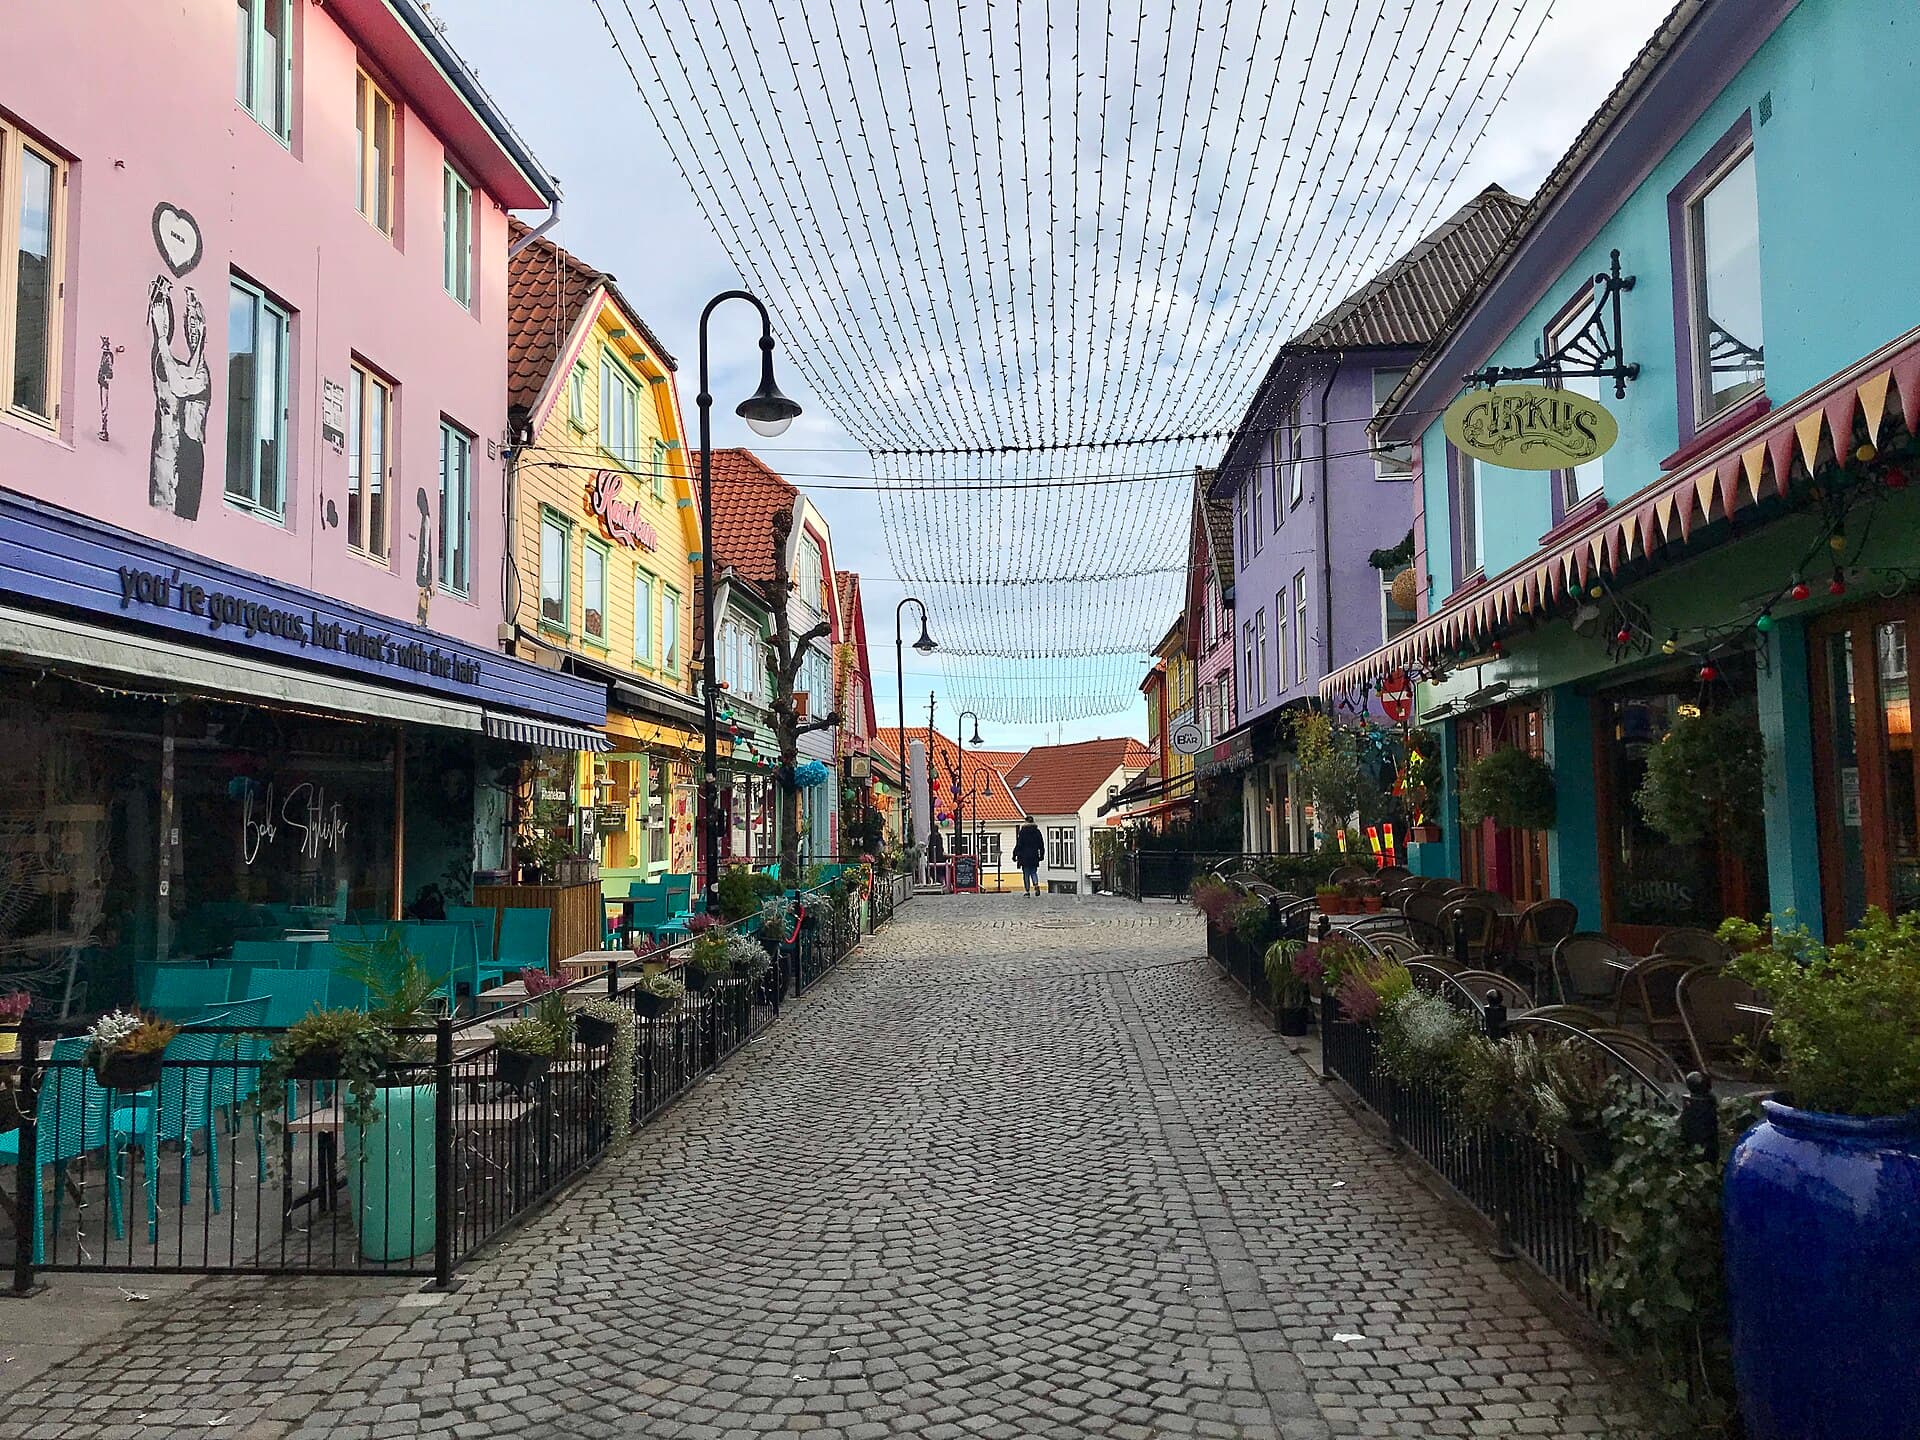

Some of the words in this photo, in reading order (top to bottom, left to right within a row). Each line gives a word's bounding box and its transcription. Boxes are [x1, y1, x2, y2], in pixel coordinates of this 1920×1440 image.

[1463, 392, 1598, 458] CIRKUS
[209, 592, 308, 648] gorgeous,
[312, 612, 342, 650] but
[397, 641, 429, 672] with
[429, 648, 451, 678] the
[452, 652, 481, 685] hair?
[1177, 735, 1198, 745] BAR
[243, 777, 277, 865] Bob
